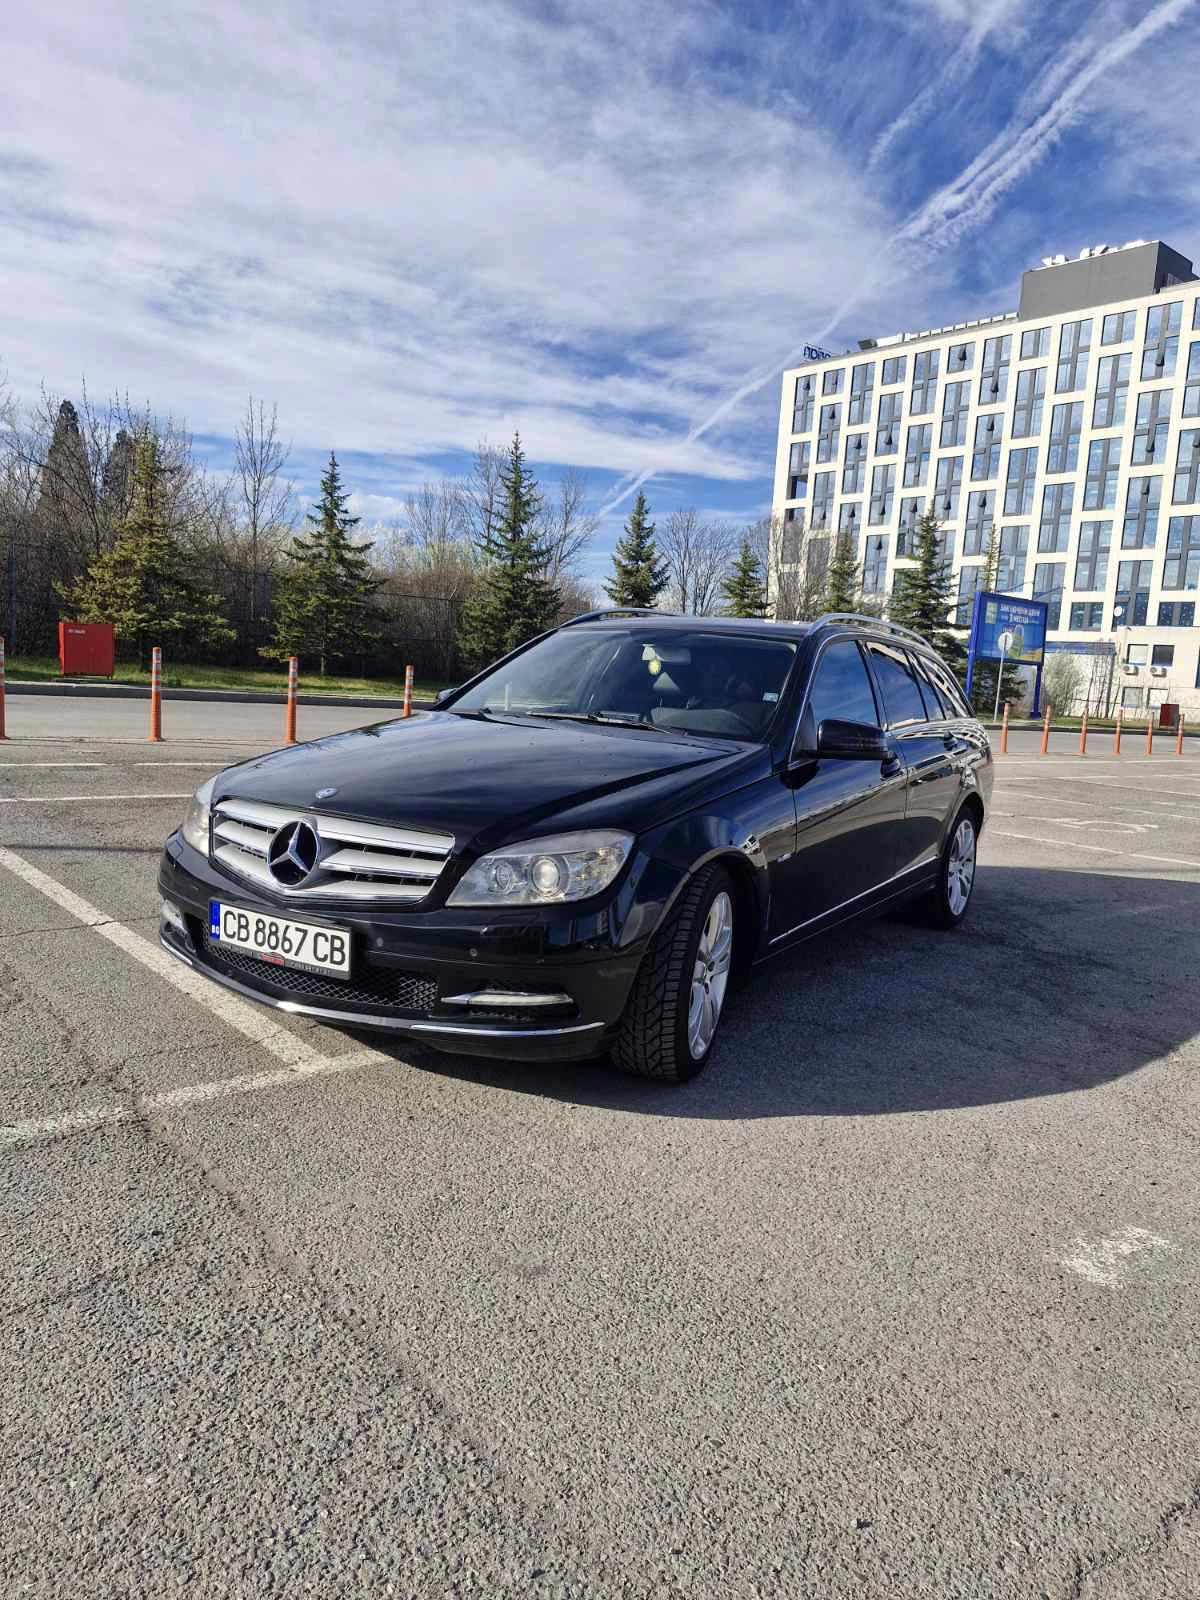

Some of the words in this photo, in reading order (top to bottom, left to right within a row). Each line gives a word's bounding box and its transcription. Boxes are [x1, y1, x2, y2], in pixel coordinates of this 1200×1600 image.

[223, 910, 250, 942] CB
[254, 918, 308, 956] 8867
[313, 932, 346, 966] CB
